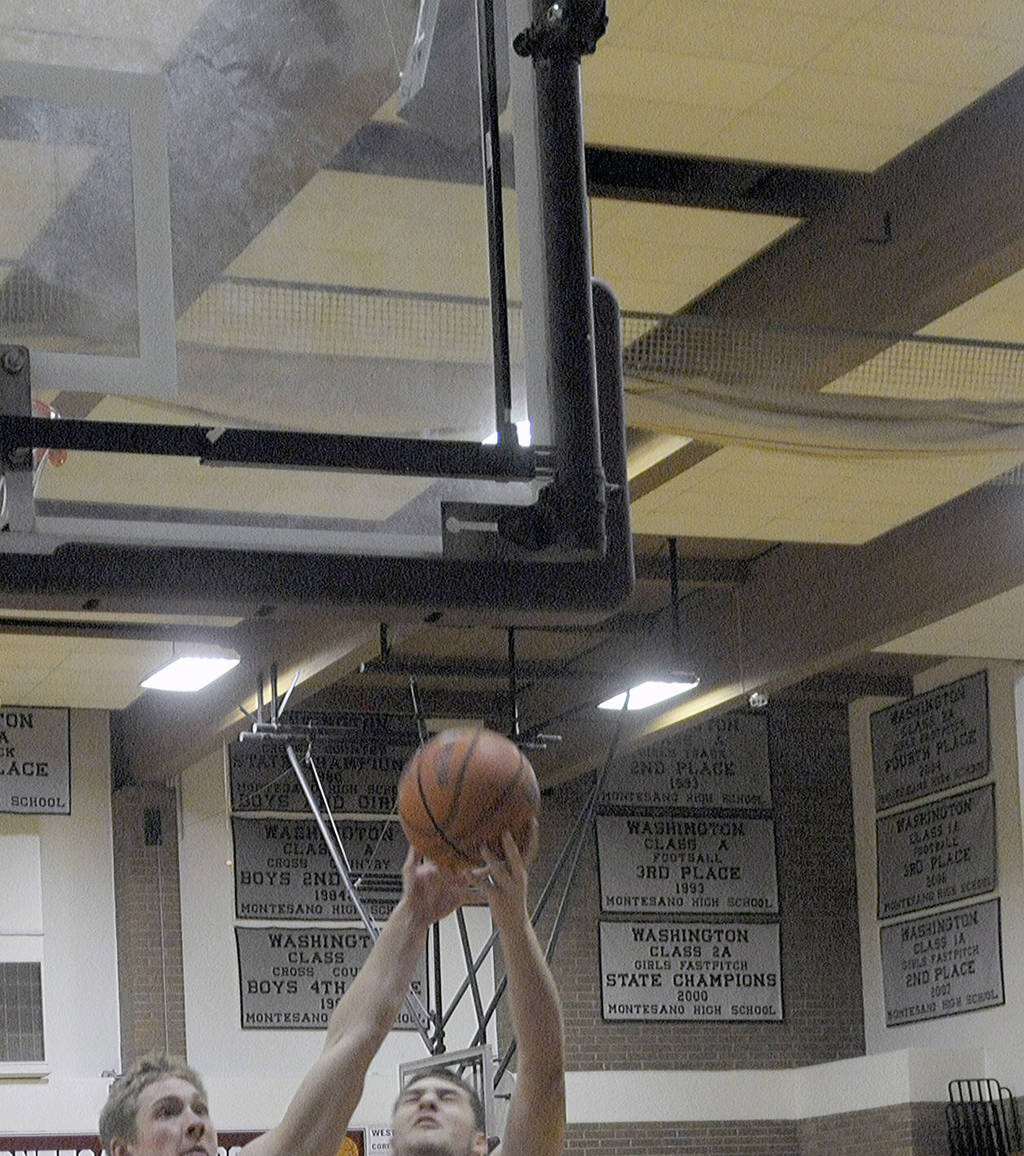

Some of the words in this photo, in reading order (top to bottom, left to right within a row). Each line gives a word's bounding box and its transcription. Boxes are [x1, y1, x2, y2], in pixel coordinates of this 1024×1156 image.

[11, 796, 66, 809] SCHOOL
[636, 865, 670, 880] 3RD
[681, 866, 741, 881] PLACE
[632, 927, 750, 943] WASHINGTON
[650, 946, 702, 958] CLASS
[712, 946, 732, 958] 2A
[635, 960, 671, 971] GIRLS
[680, 961, 749, 971] FASTPITCH
[934, 960, 976, 982] PLACE
[247, 980, 298, 994] BOYS
[310, 981, 346, 994] 4TH
[606, 973, 662, 987] STATE
[673, 973, 777, 988] CHAMPIONS
[677, 990, 709, 1002] 2000
[608, 1004, 685, 1015] MONTESANO
[693, 1005, 722, 1016] HIGH
[731, 1005, 777, 1016] SCHOOL
[246, 1013, 328, 1024] MONTESANO
